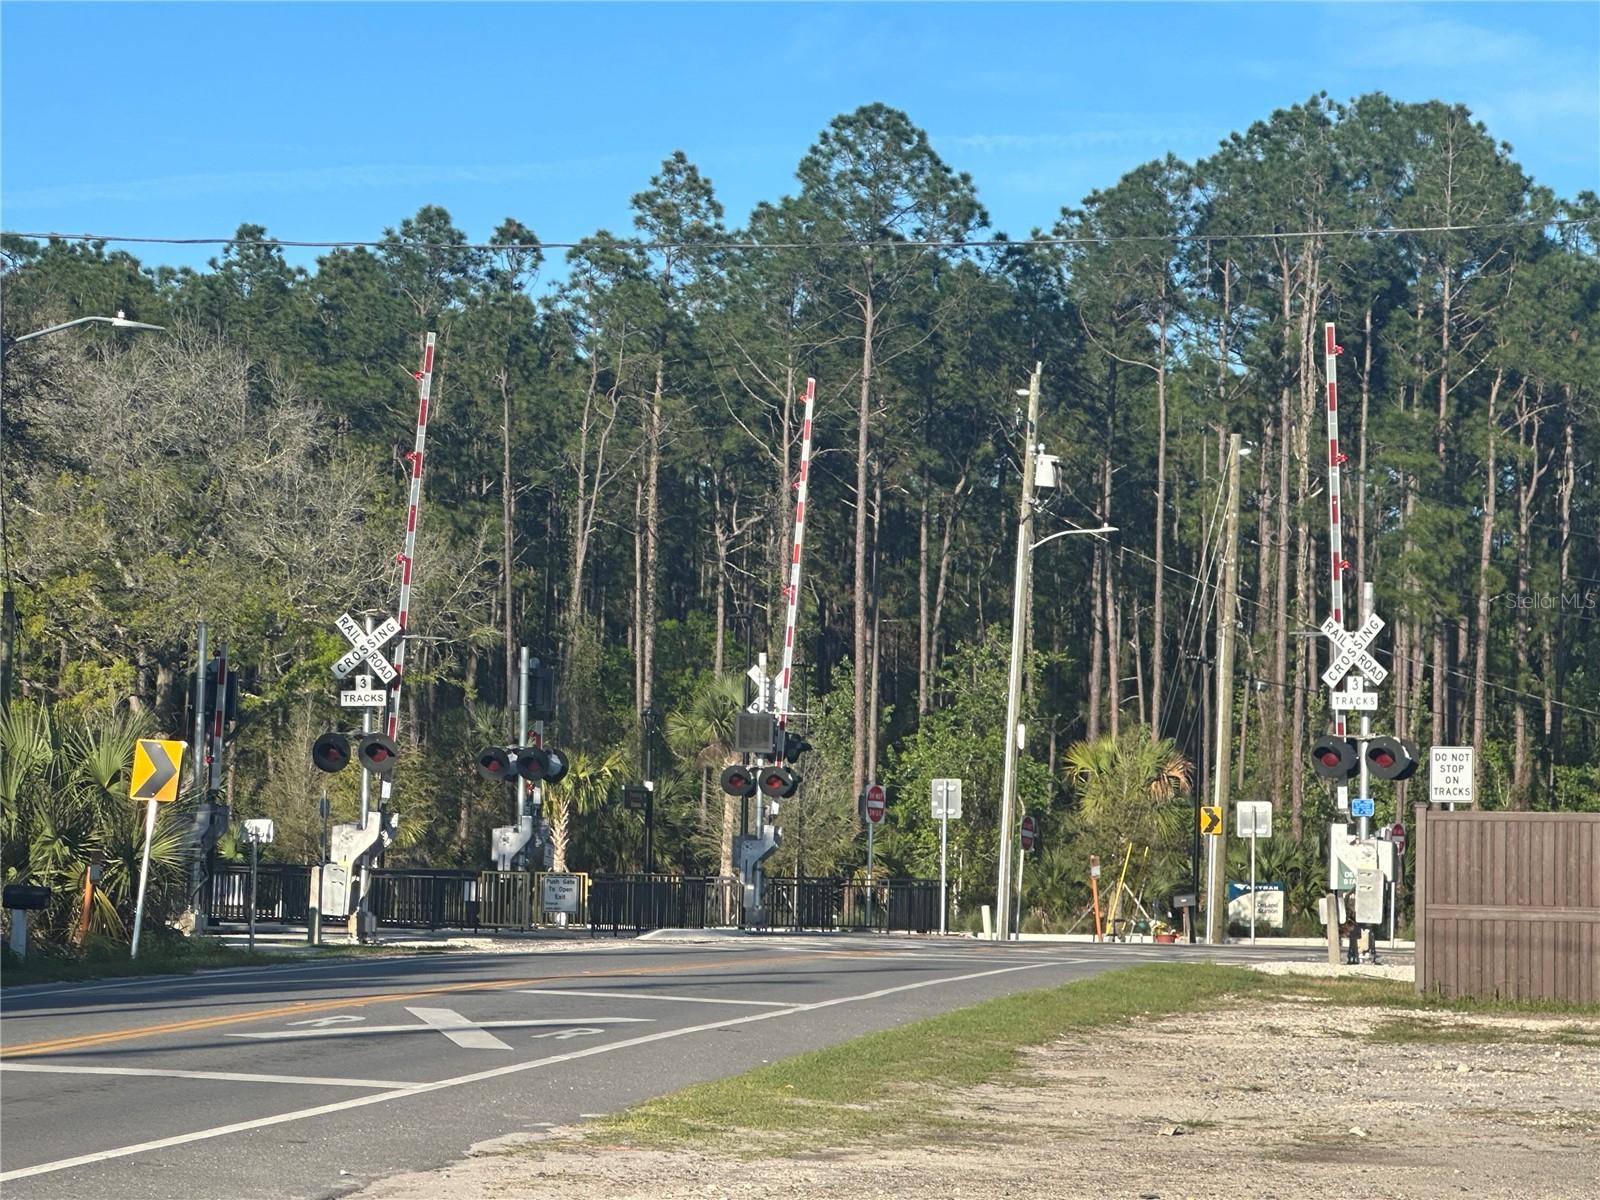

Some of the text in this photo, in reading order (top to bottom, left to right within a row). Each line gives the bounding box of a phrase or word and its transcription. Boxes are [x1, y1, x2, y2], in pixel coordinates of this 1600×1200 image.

[337, 622, 395, 673] CROSSING
[339, 616, 393, 680] RAIL ROAD
[1324, 621, 1384, 681] RAIL ROAD
[1328, 619, 1379, 681] CROSSING
[360, 678, 367, 689] 3
[1352, 680, 1359, 690] 3
[343, 694, 384, 702] TRACKS
[1335, 696, 1375, 706] TRACKS
[1434, 752, 1470, 762] DO NOT
[1440, 764, 1465, 773] STOP
[1445, 775, 1459, 784] ON
[1434, 787, 1471, 796] TRACKS
